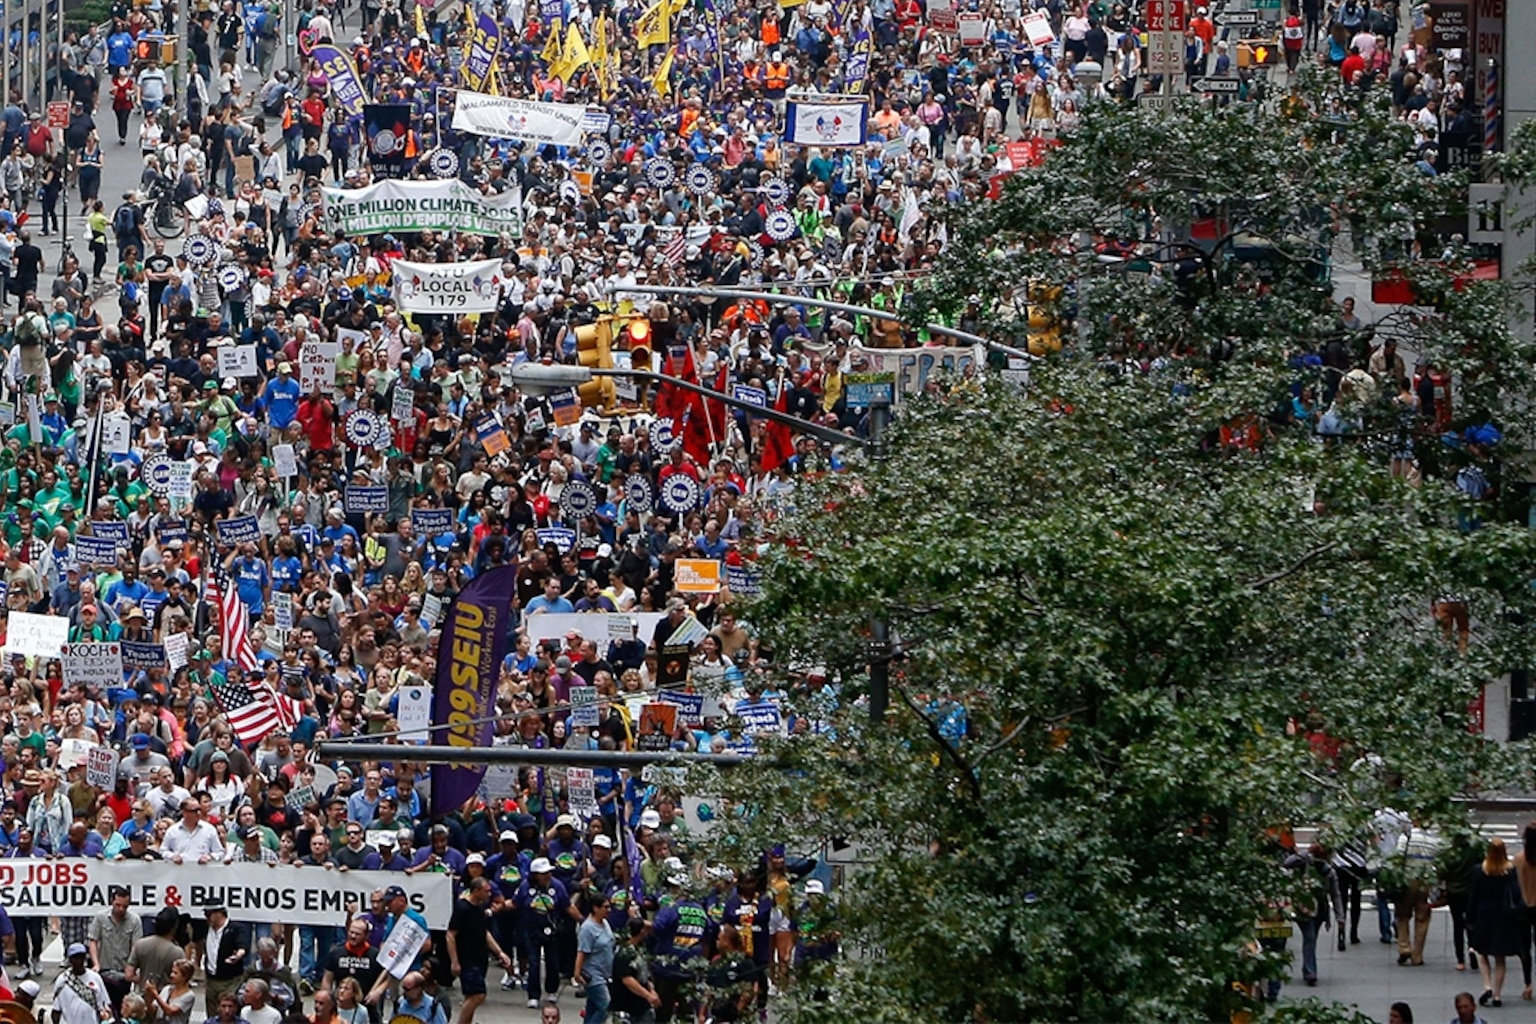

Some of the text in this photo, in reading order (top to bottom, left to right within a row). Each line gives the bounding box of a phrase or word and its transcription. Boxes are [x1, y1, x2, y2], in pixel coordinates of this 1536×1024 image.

[1155, 3, 1176, 14] RD
[1478, 32, 1501, 54] BUY
[1152, 51, 1179, 63] $25
[327, 197, 518, 220] ONE MILLION CLIMATE JOBS
[420, 279, 472, 293] LOCAL
[427, 293, 465, 307] 1179
[68, 644, 110, 657] KOCH
[89, 747, 113, 762] STOP
[21, 864, 88, 887] JOBS
[164, 885, 182, 907] &
[190, 886, 296, 911] BUENOS
